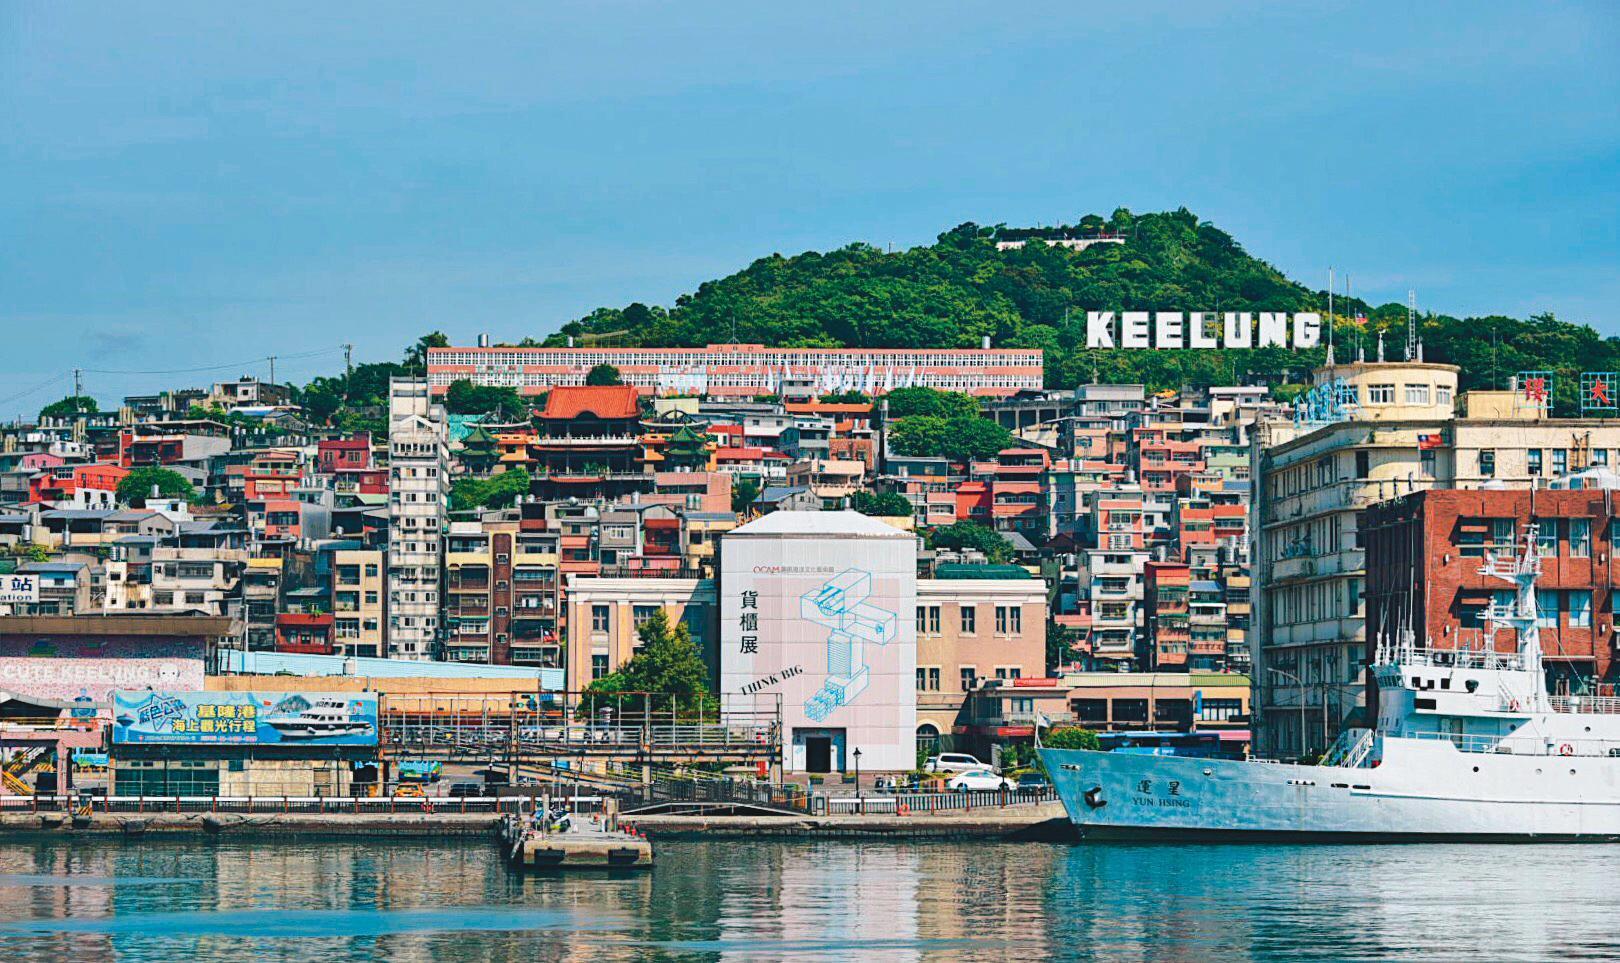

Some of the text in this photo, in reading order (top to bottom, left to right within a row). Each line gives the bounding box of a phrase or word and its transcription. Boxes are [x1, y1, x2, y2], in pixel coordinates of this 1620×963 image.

[1086, 311, 1321, 349] KEELUNG
[740, 590, 758, 654] 貨櫃展
[3, 665, 150, 683] CUTE KEELUNG
[740, 664, 804, 696] THINK BIG
[172, 718, 257, 734] 海上觀光行程
[1132, 797, 1154, 806] YUN
